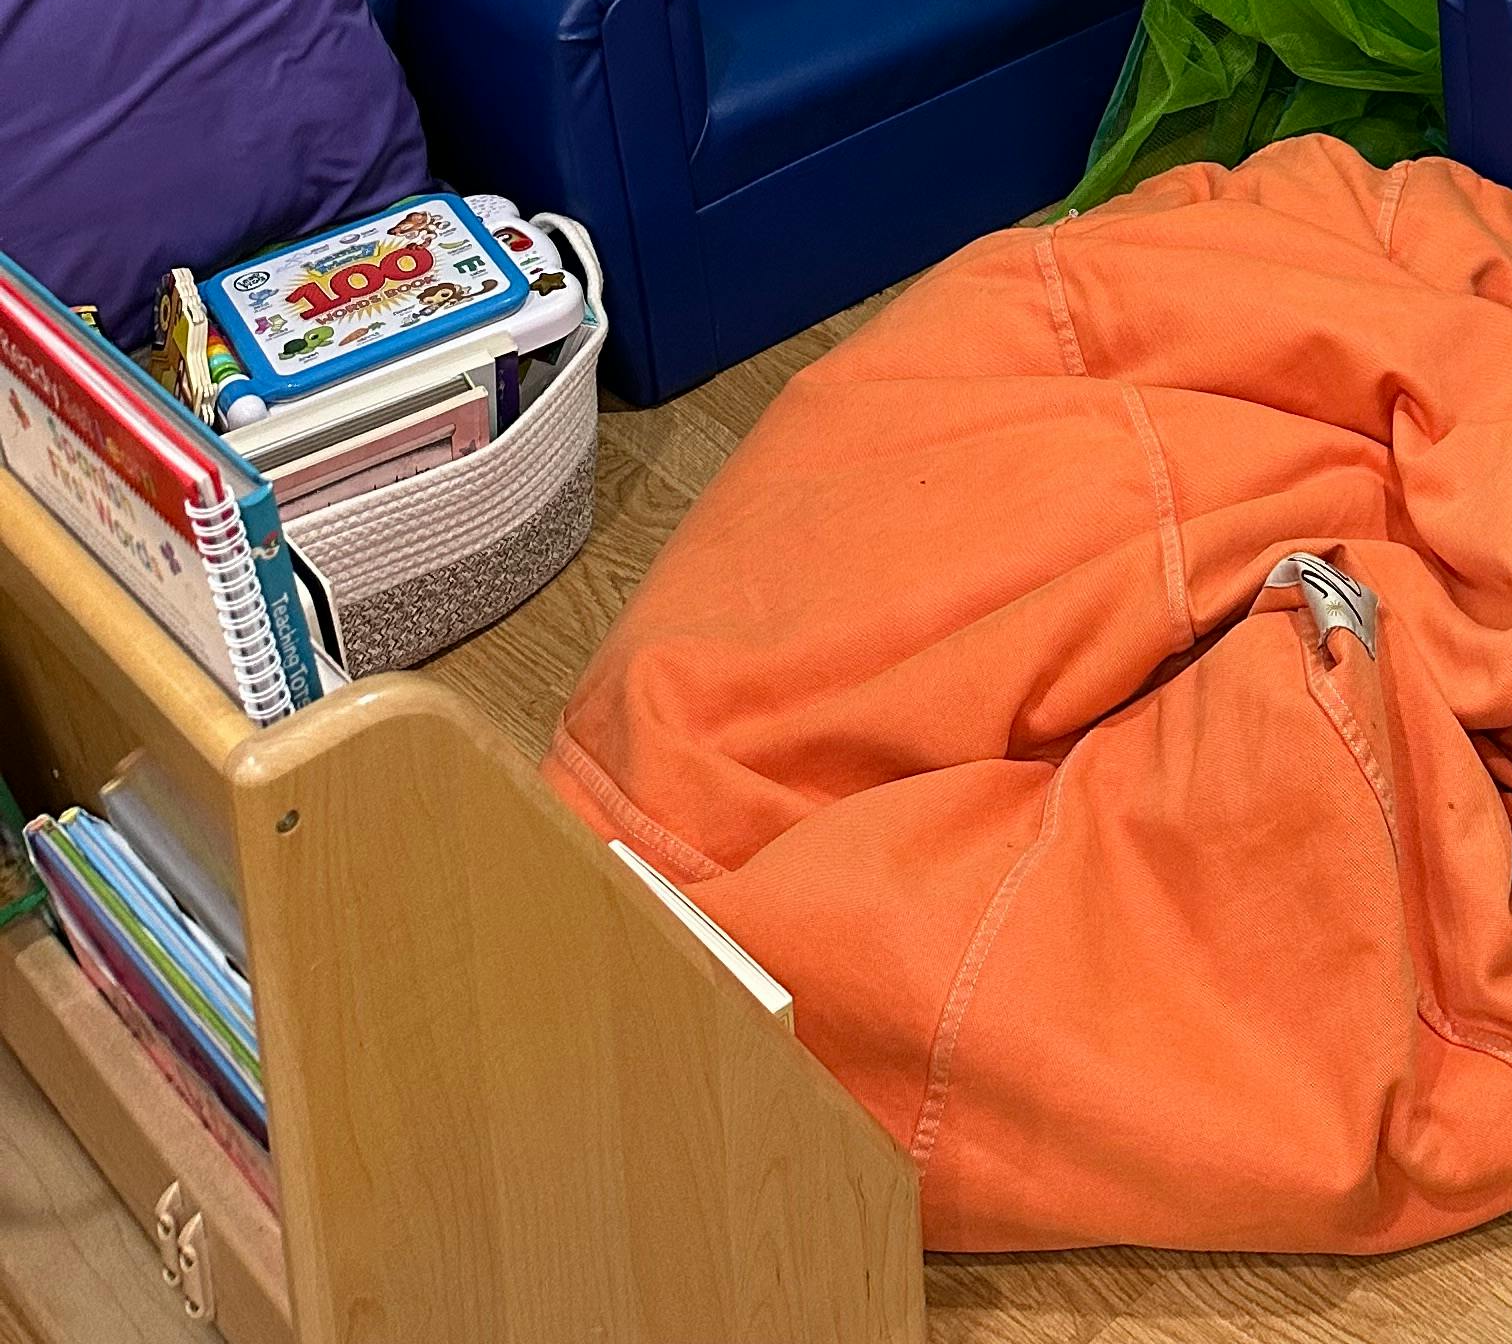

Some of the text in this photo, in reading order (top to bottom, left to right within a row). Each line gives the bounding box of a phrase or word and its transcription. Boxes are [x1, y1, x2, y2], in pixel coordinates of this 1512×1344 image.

[285, 243, 435, 321] 100
[315, 295, 382, 325] WORDS
[383, 274, 438, 299] BOOK
[270, 592, 300, 668] Teaching
